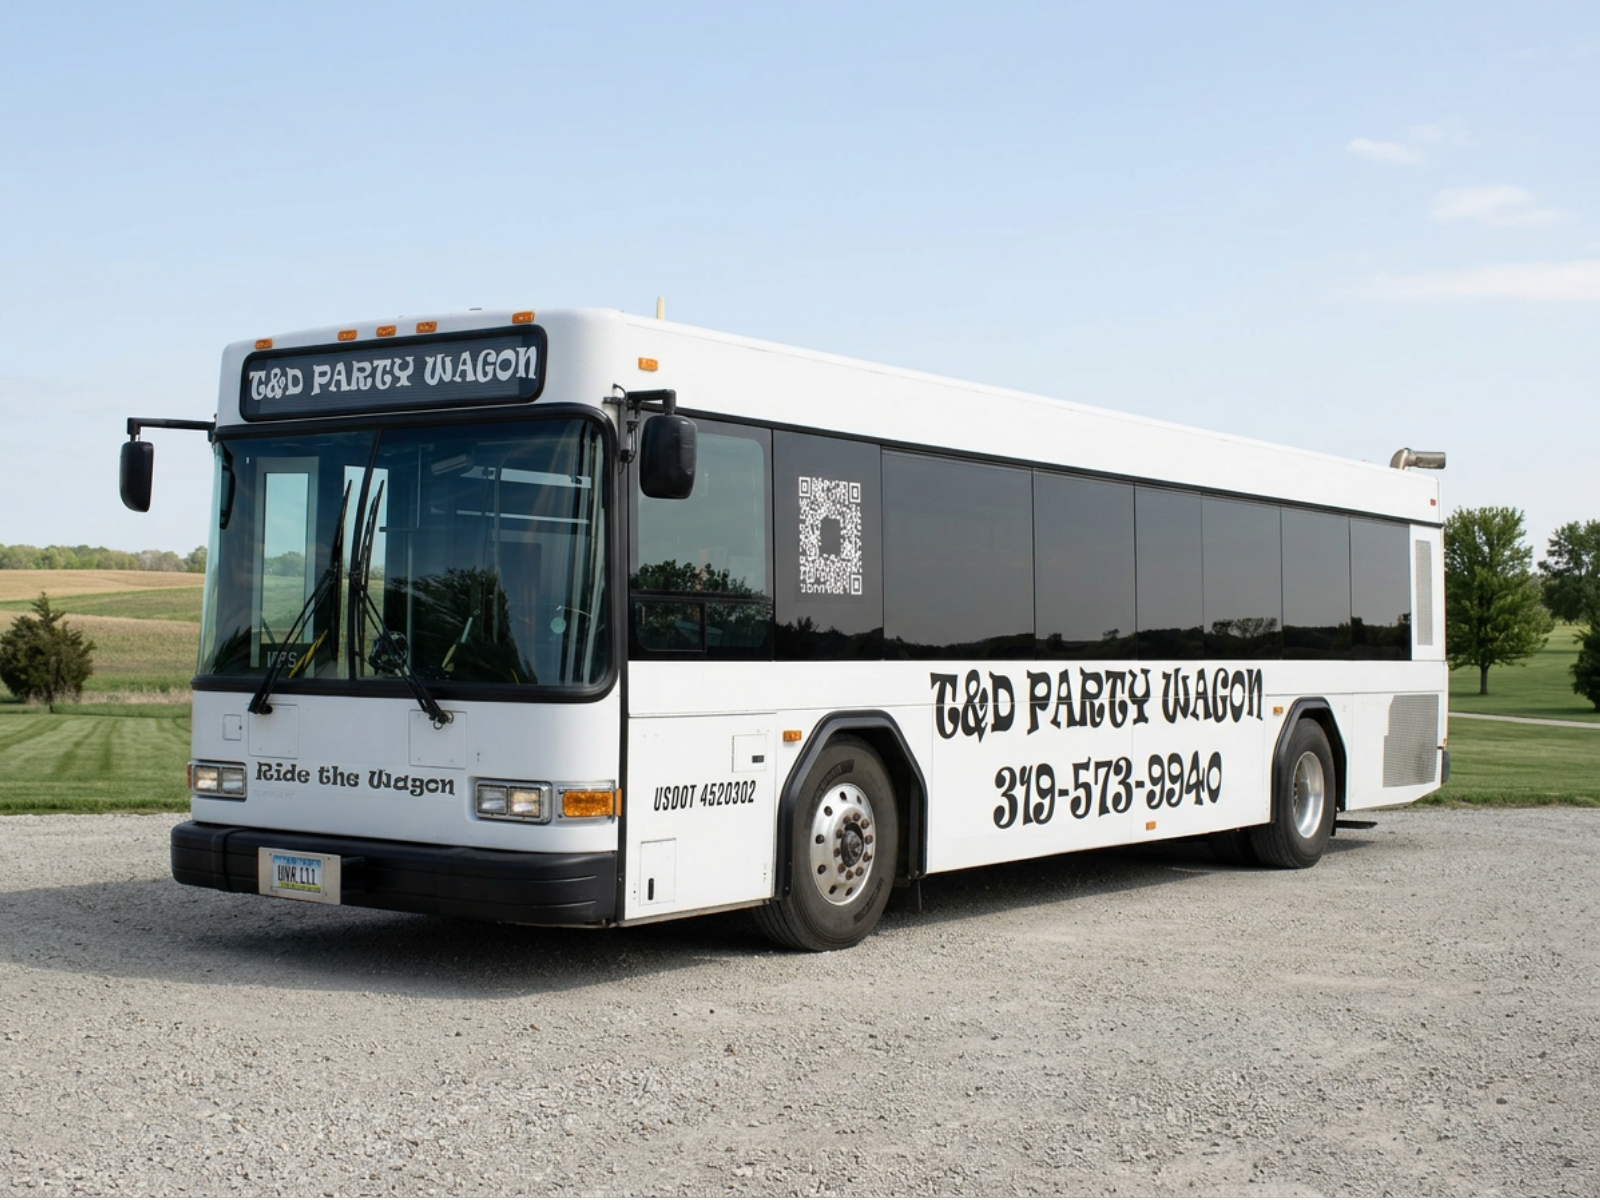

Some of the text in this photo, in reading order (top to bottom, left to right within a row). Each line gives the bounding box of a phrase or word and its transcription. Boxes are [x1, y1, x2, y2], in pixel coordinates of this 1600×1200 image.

[249, 345, 537, 401] T&D PARTY WAGON
[930, 666, 1263, 743] T&D PARTY WAGON
[255, 761, 455, 797] Ride the Wagon
[653, 779, 757, 811] USDOT 4520302
[993, 750, 1222, 829] 319-573-9940
